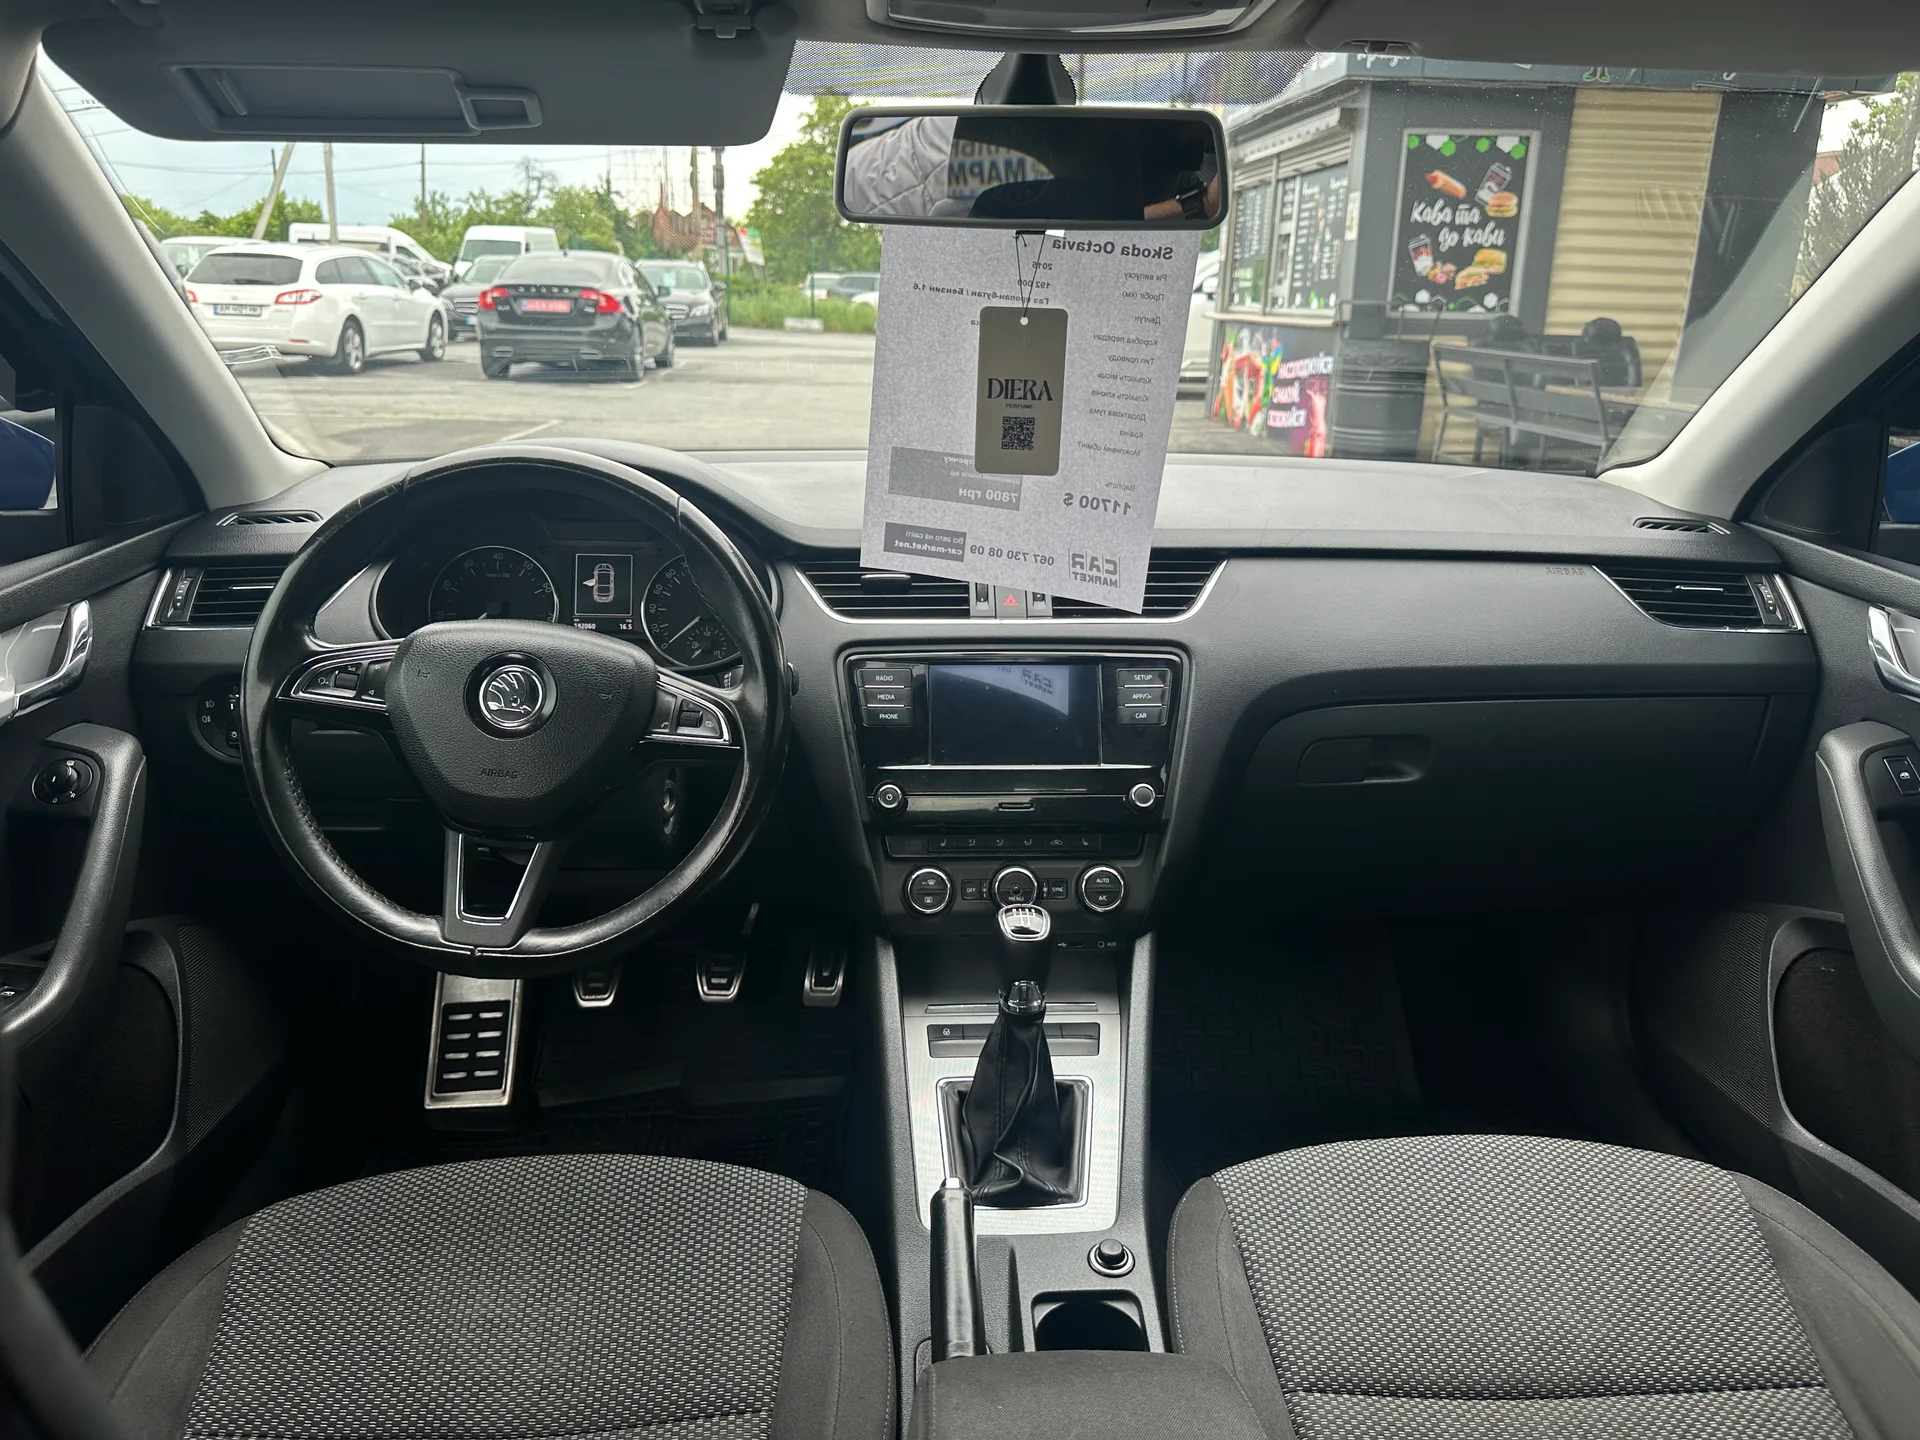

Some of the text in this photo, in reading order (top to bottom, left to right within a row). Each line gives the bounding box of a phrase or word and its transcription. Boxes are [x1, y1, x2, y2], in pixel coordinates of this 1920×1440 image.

[987, 378, 1053, 401] DIERA
[463, 559, 474, 568] 30
[522, 560, 533, 570] 50
[665, 568, 676, 579] 80
[1546, 567, 1585, 576] AIRBAG
[443, 580, 452, 591] 20
[543, 582, 551, 593] 60
[654, 584, 663, 595] 60
[649, 604, 656, 614] 40
[651, 624, 659, 633] 20
[480, 768, 518, 778] AIRBAG
